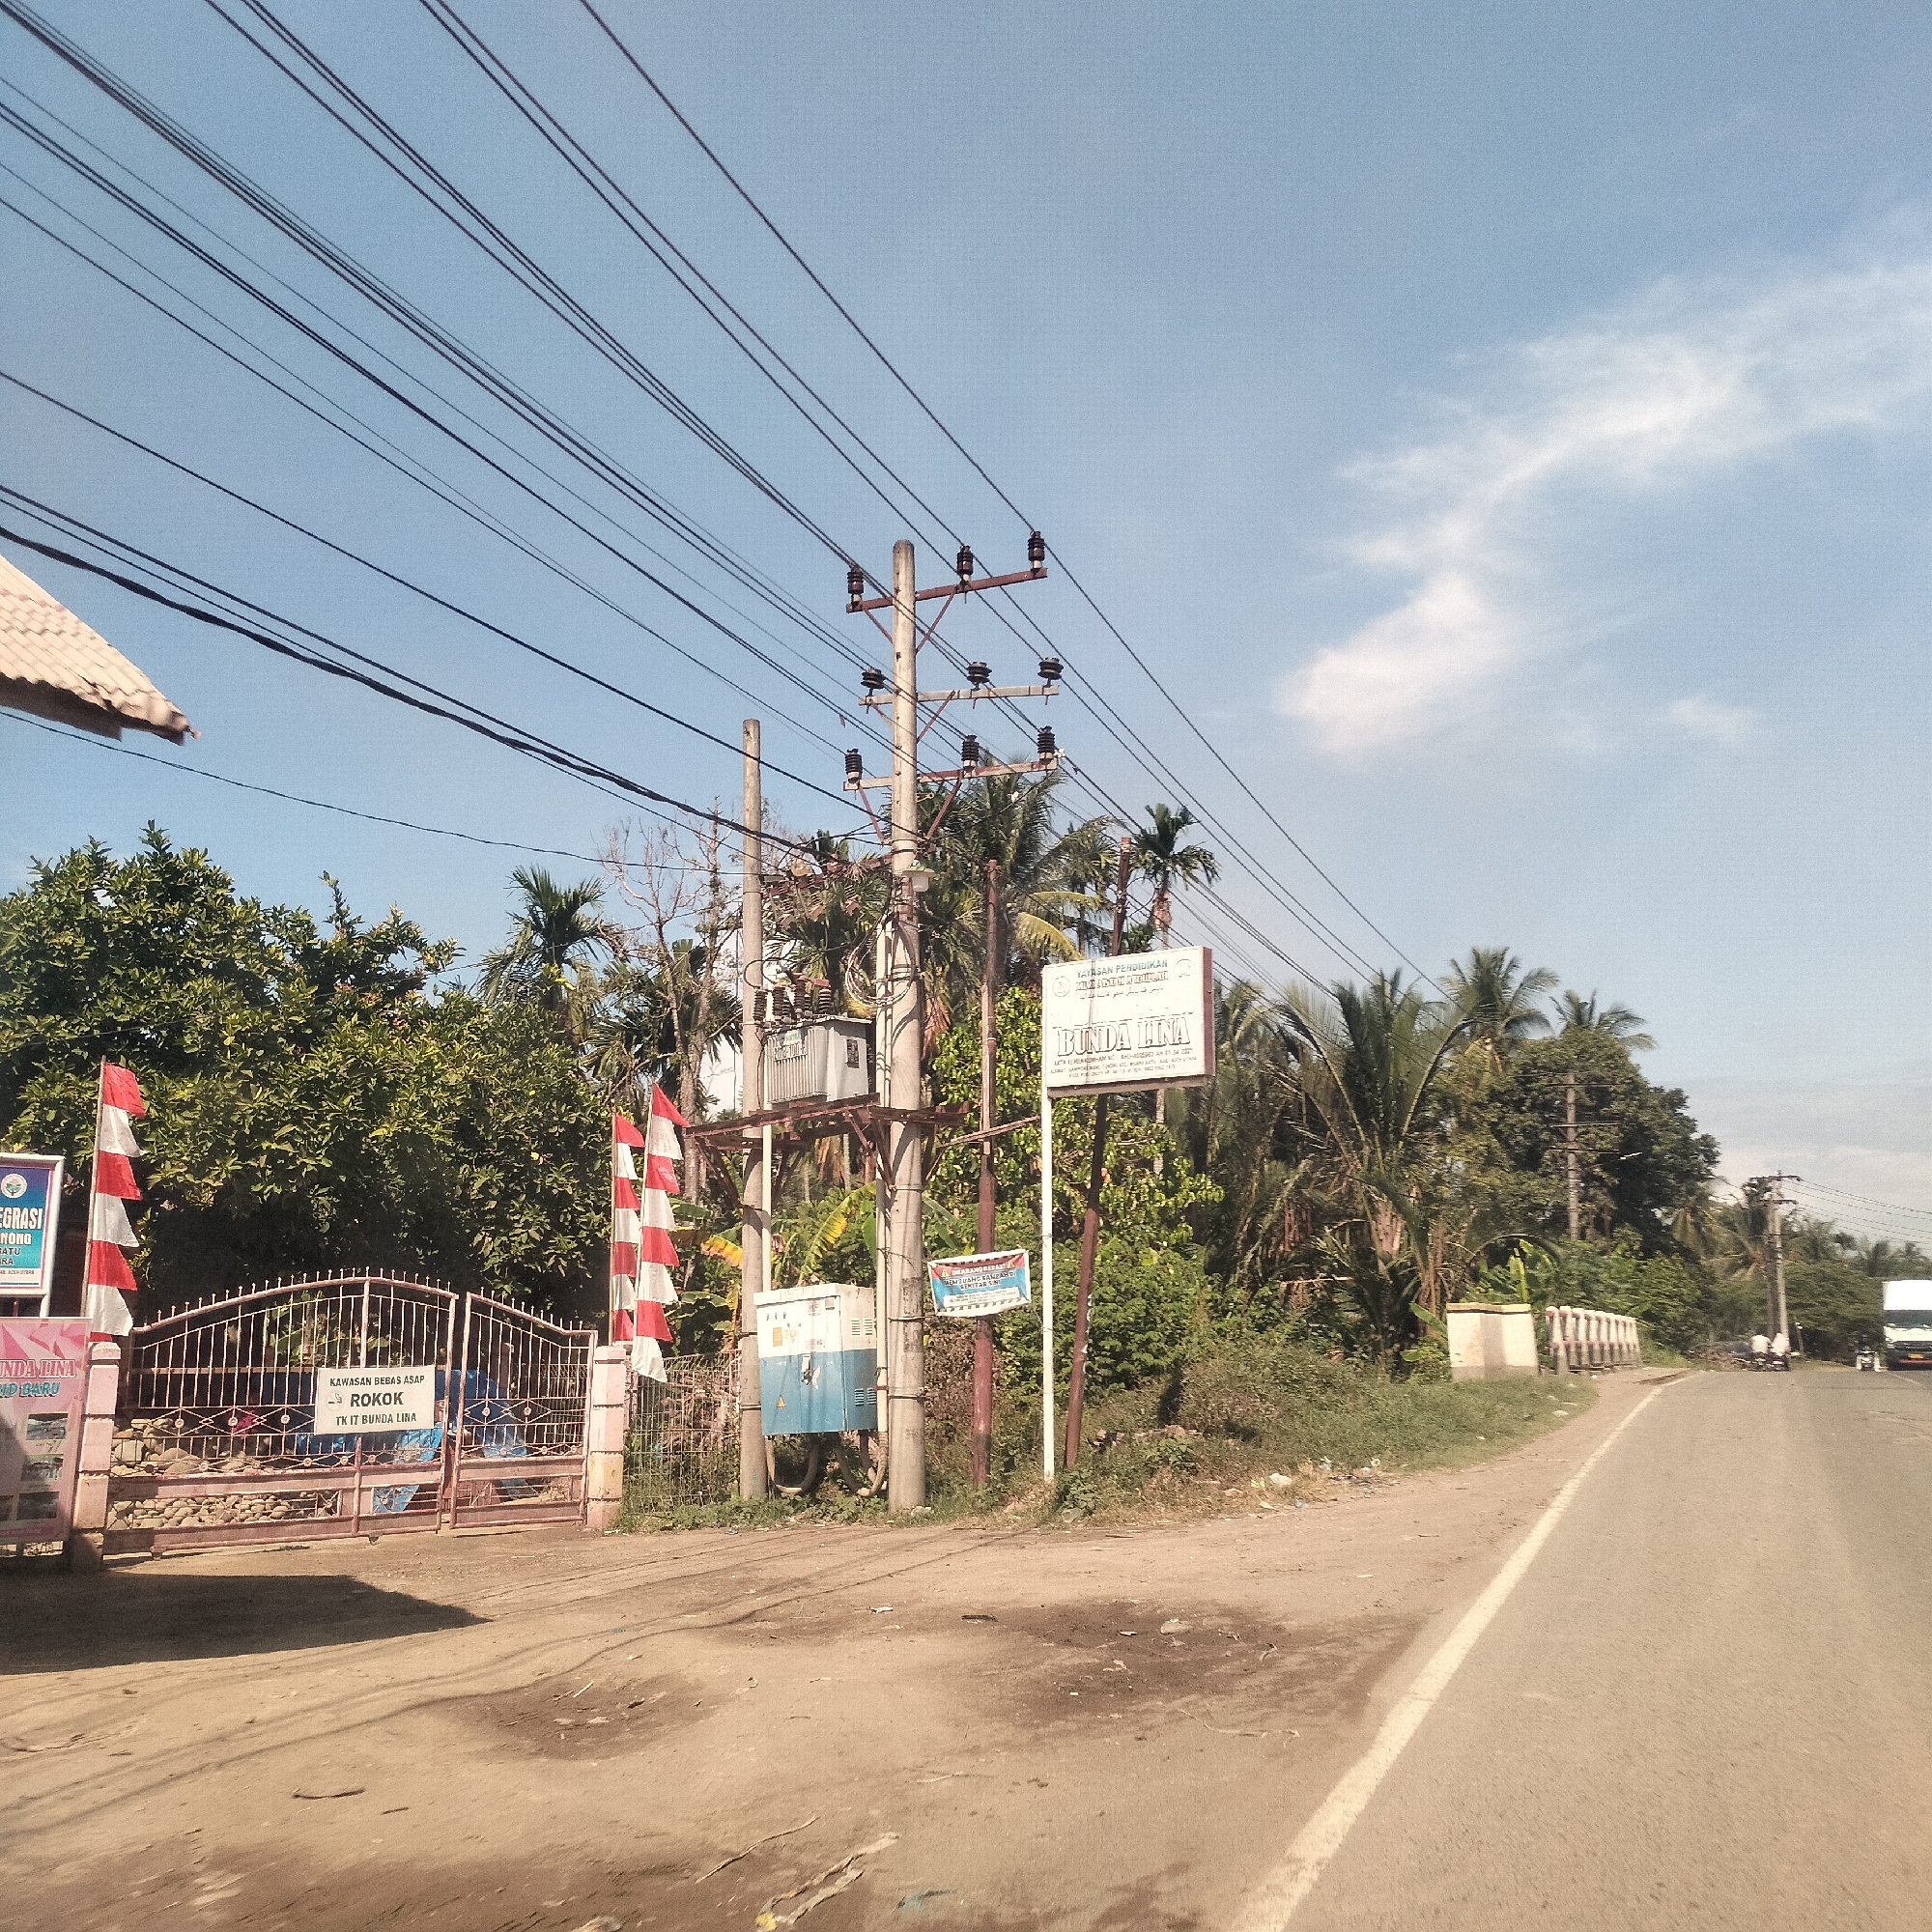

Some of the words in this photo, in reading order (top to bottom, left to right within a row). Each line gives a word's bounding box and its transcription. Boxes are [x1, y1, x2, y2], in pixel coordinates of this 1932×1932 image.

[1077, 966, 1113, 978] YAYASAN
[1116, 959, 1167, 973] PENDIDIKAN
[1058, 1023, 1131, 1057] BUNDA
[1137, 1017, 1190, 1048] LINA
[39, 1359, 76, 1378] LINA
[20, 1381, 61, 1397] BARU
[329, 1377, 372, 1387] KAWASAN
[374, 1376, 402, 1385] BEBAS
[403, 1375, 425, 1384] ASAP
[350, 1391, 405, 1407] ROKOK
[335, 1415, 348, 1426] TK
[350, 1414, 359, 1426] IT
[361, 1413, 394, 1425] BUNDA
[396, 1412, 417, 1423] LINA
